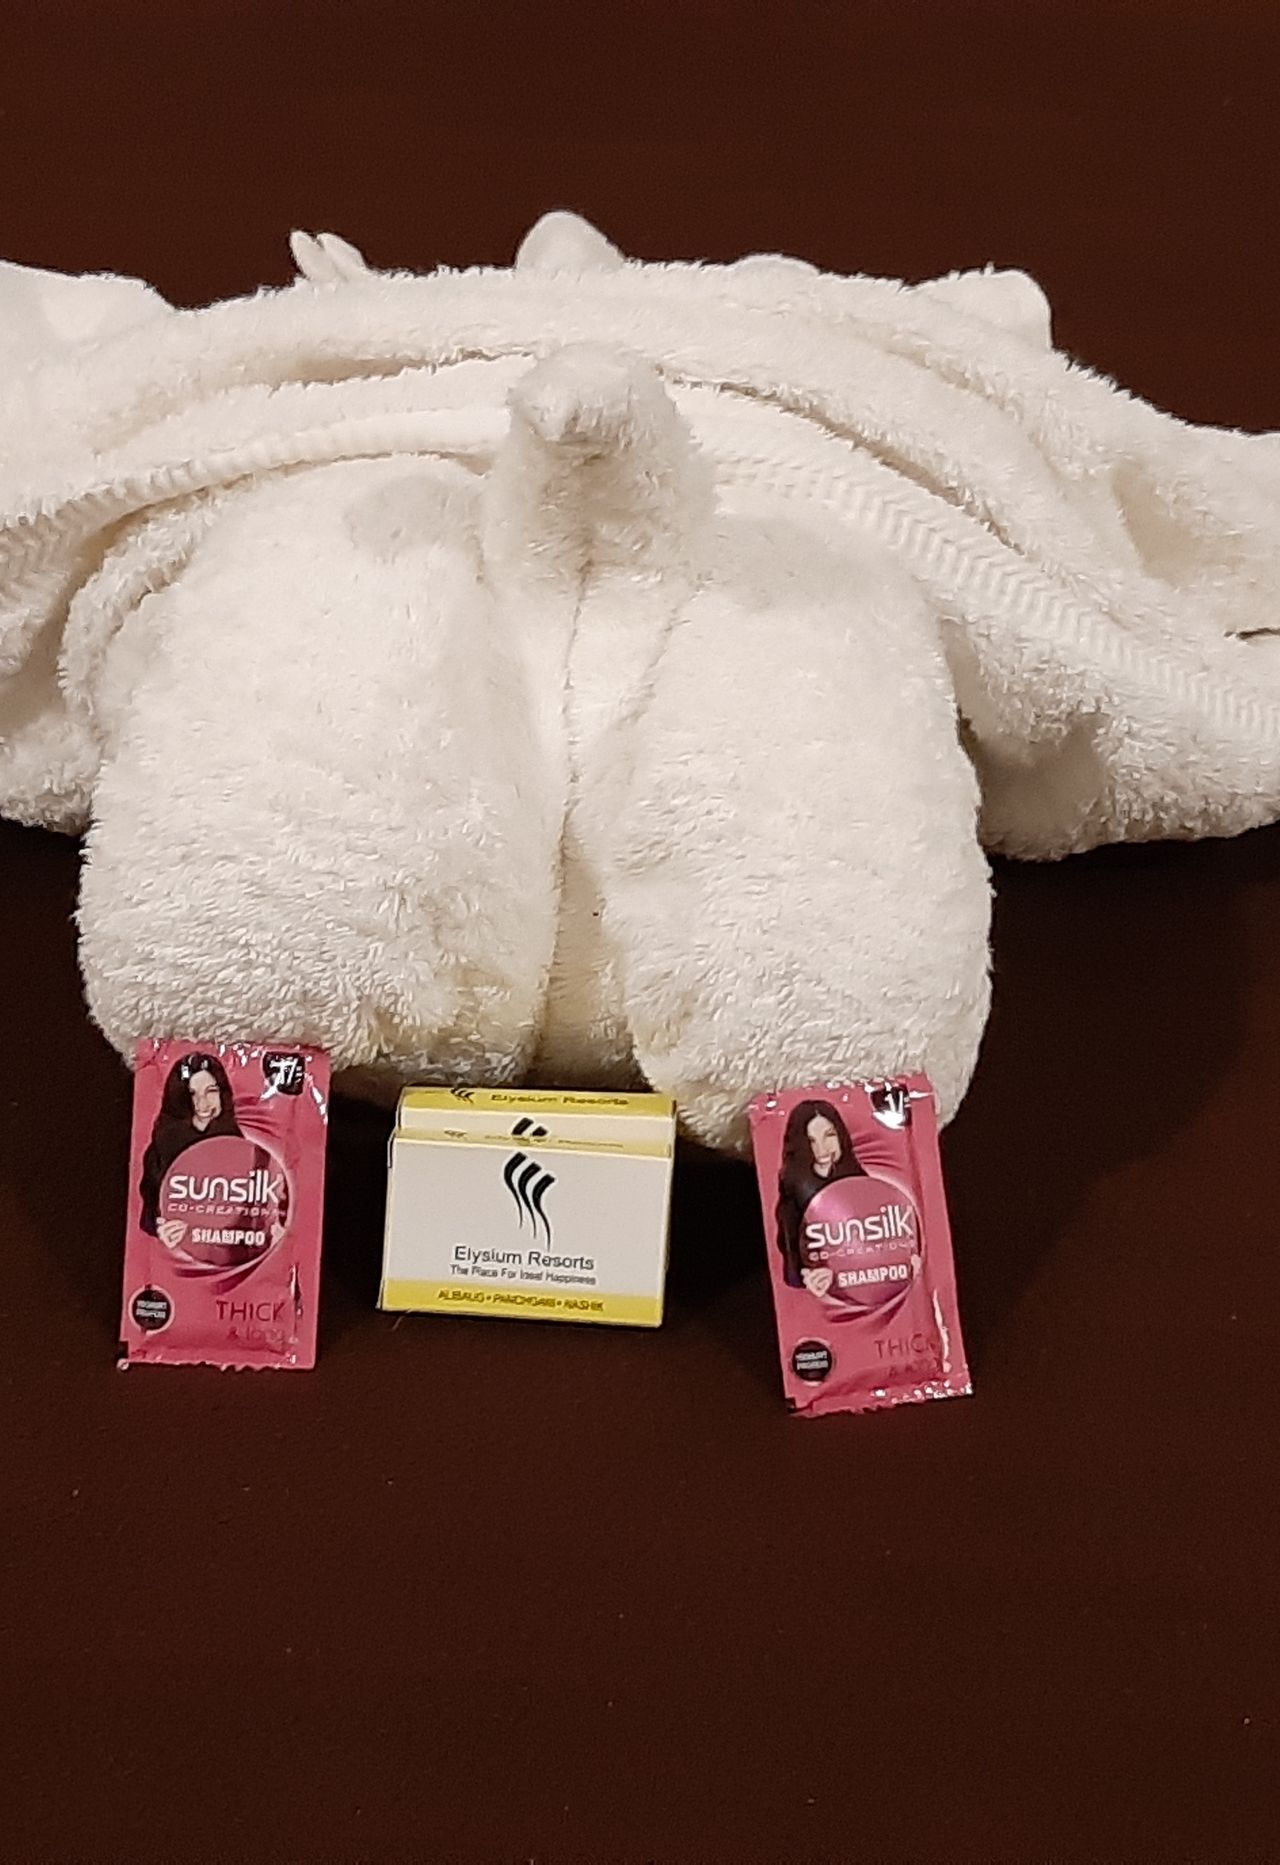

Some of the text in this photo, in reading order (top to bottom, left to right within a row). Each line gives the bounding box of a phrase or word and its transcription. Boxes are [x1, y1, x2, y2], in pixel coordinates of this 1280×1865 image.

[491, 1094, 630, 1106] Elysium Resorts
[191, 1226, 266, 1246] SHAMPOO
[454, 1245, 595, 1271] Elysium Resorts
[450, 1264, 468, 1275] The
[472, 1266, 498, 1278] Place
[501, 1267, 517, 1279] For
[837, 1264, 908, 1288] SHAMPOO
[216, 1300, 286, 1321] THICK
